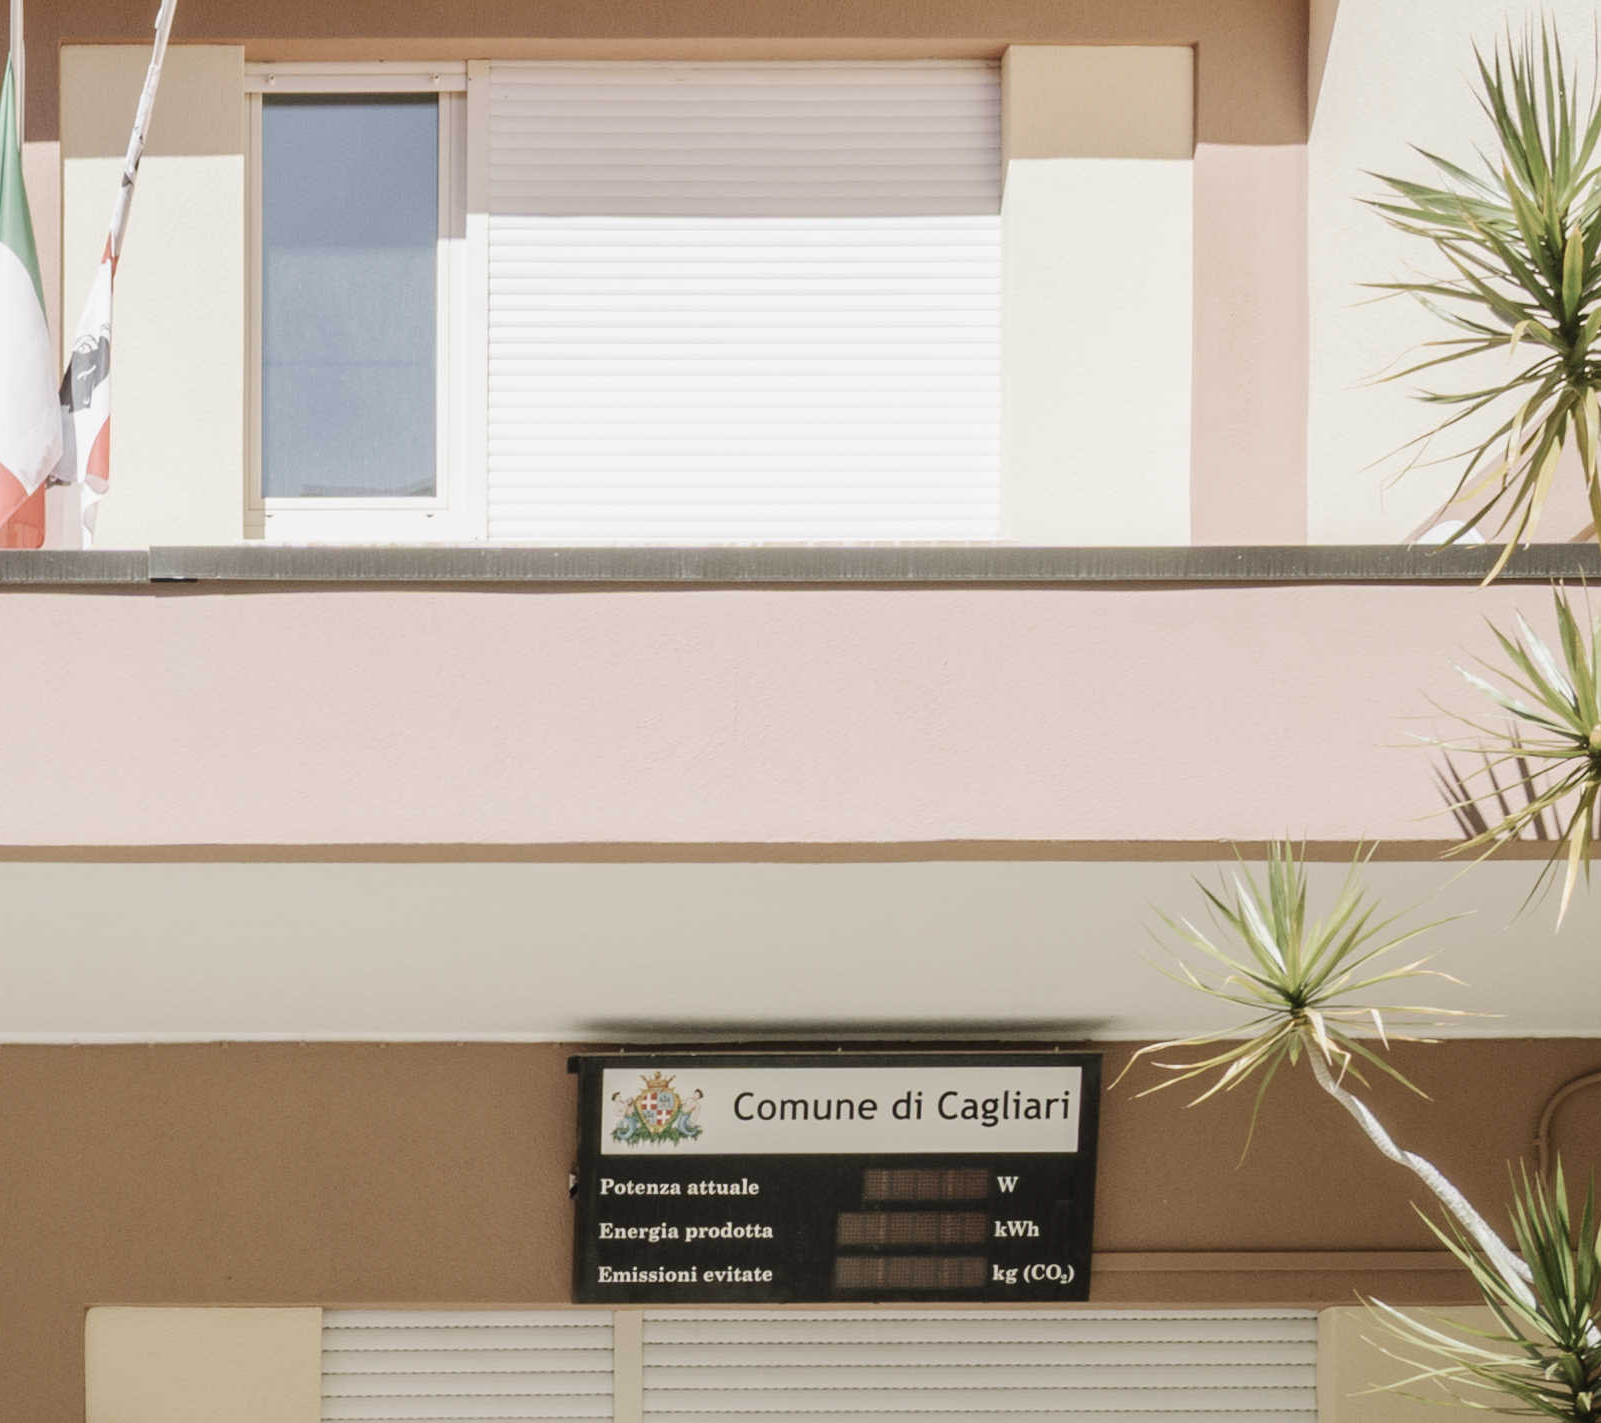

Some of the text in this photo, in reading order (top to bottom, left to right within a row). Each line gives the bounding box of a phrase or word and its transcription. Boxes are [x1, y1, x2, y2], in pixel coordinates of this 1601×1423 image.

[734, 1090, 1070, 1127] Comune di Cagliari
[600, 1179, 759, 1196] Potenza attuale
[997, 1177, 1019, 1193] W
[599, 1223, 773, 1242] Energia prodotta
[994, 1221, 1040, 1237] kWh
[598, 1267, 773, 1283] Emissioni evitate
[993, 1265, 1018, 1284] kg
